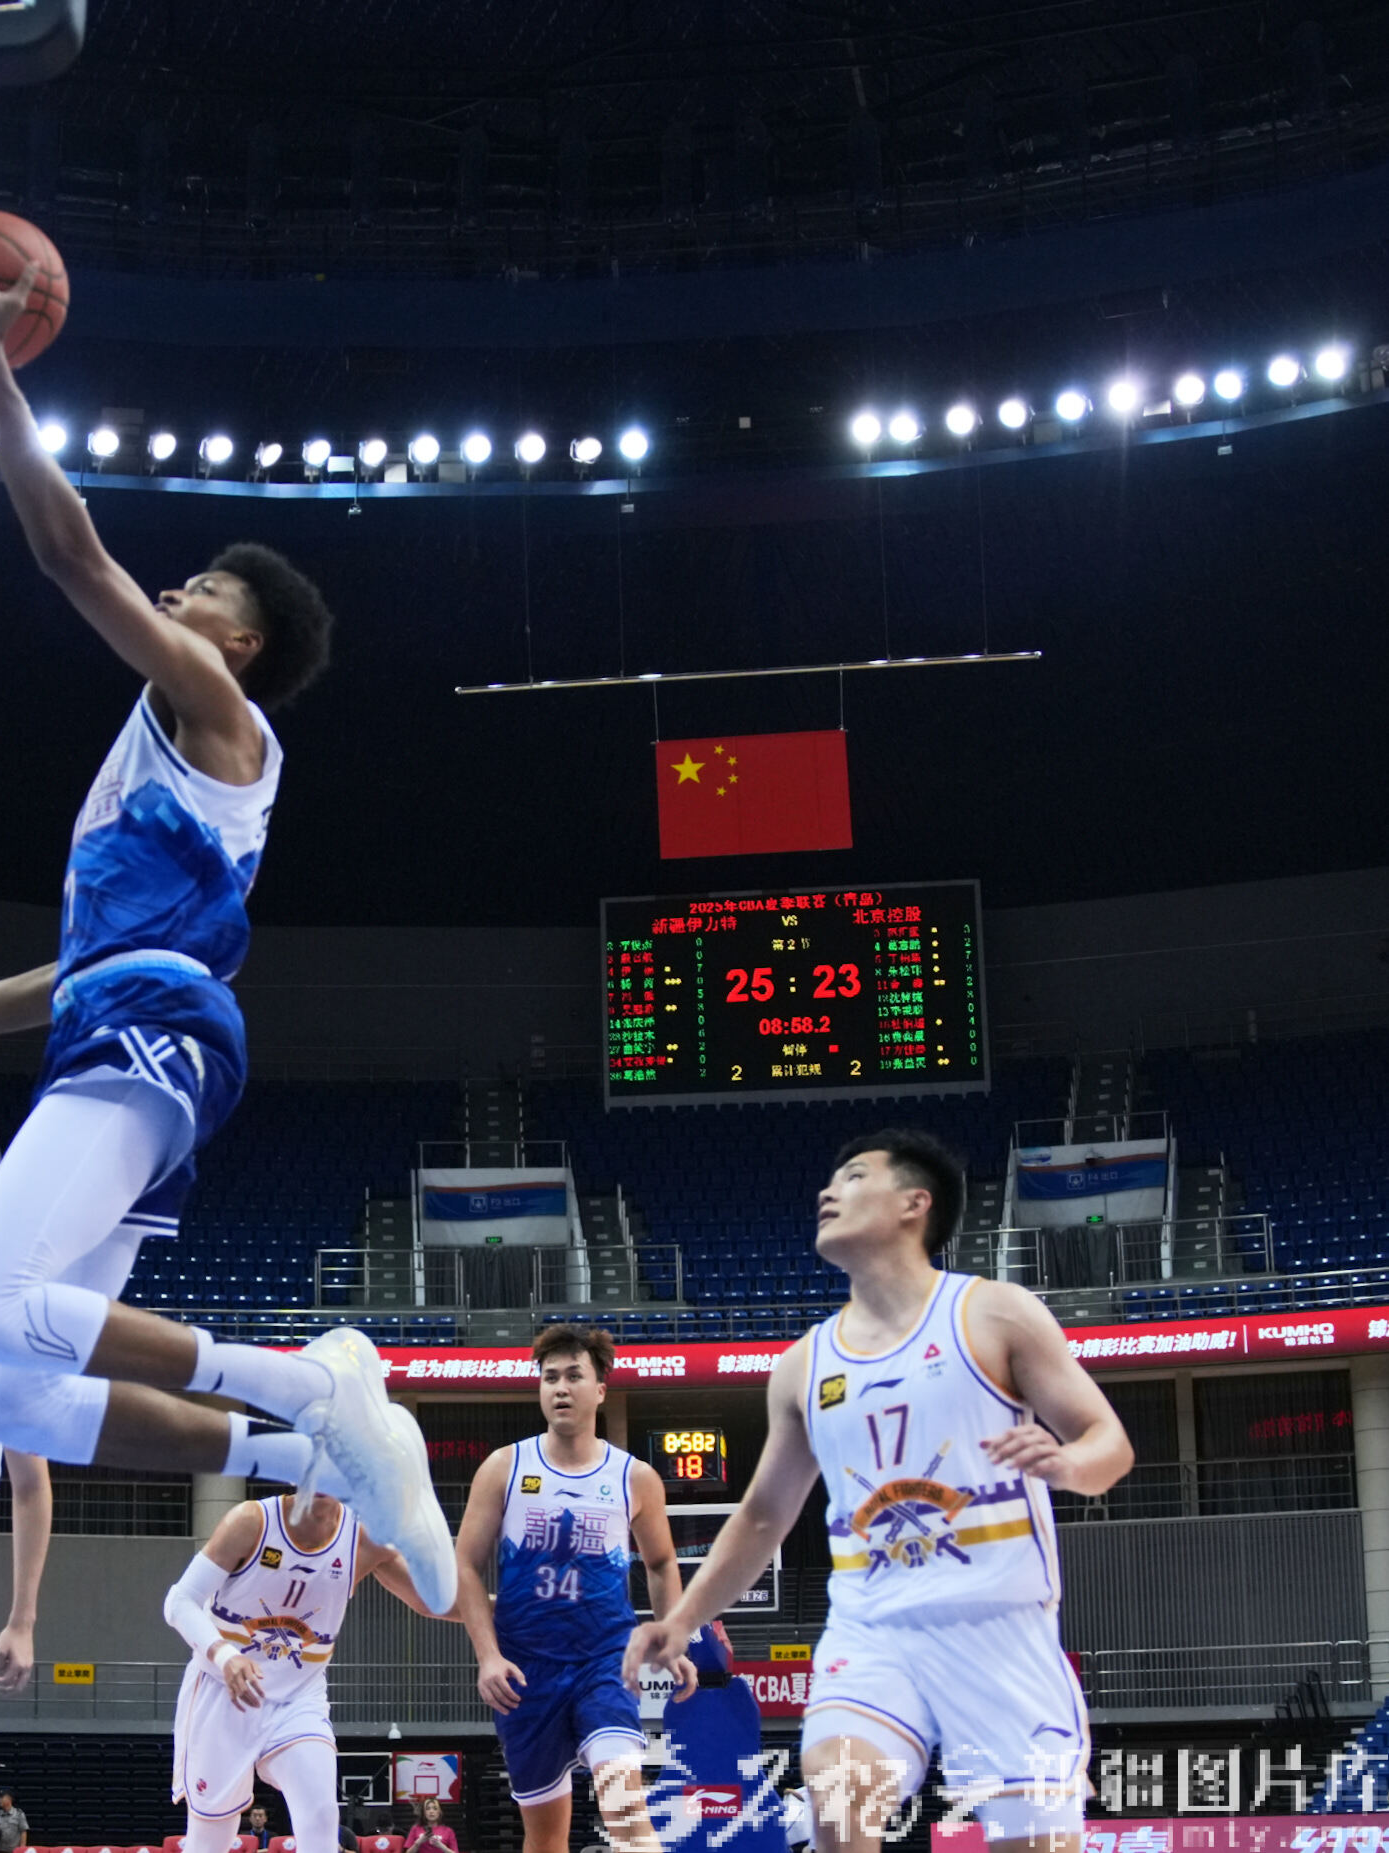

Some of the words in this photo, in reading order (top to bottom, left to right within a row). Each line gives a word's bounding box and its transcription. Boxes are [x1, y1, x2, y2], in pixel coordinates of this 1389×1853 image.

[651, 915, 738, 935] 新疆伊力特
[781, 915, 798, 927] VS
[852, 906, 923, 925] 北京控股
[725, 967, 775, 1003] 25
[812, 963, 861, 999] 23
[759, 1015, 831, 1036] 08:58.2
[731, 1064, 743, 1081] 2
[771, 1063, 822, 1077] 累计犯规
[849, 1060, 862, 1076] 2
[1258, 1322, 1335, 1340] KUMHO
[613, 1356, 686, 1369] KUMHO
[867, 1403, 909, 1471] 17
[676, 1454, 703, 1479] 18
[523, 1506, 610, 1556] 新疆
[282, 1579, 307, 1609] 11
[534, 1565, 580, 1603] 34
